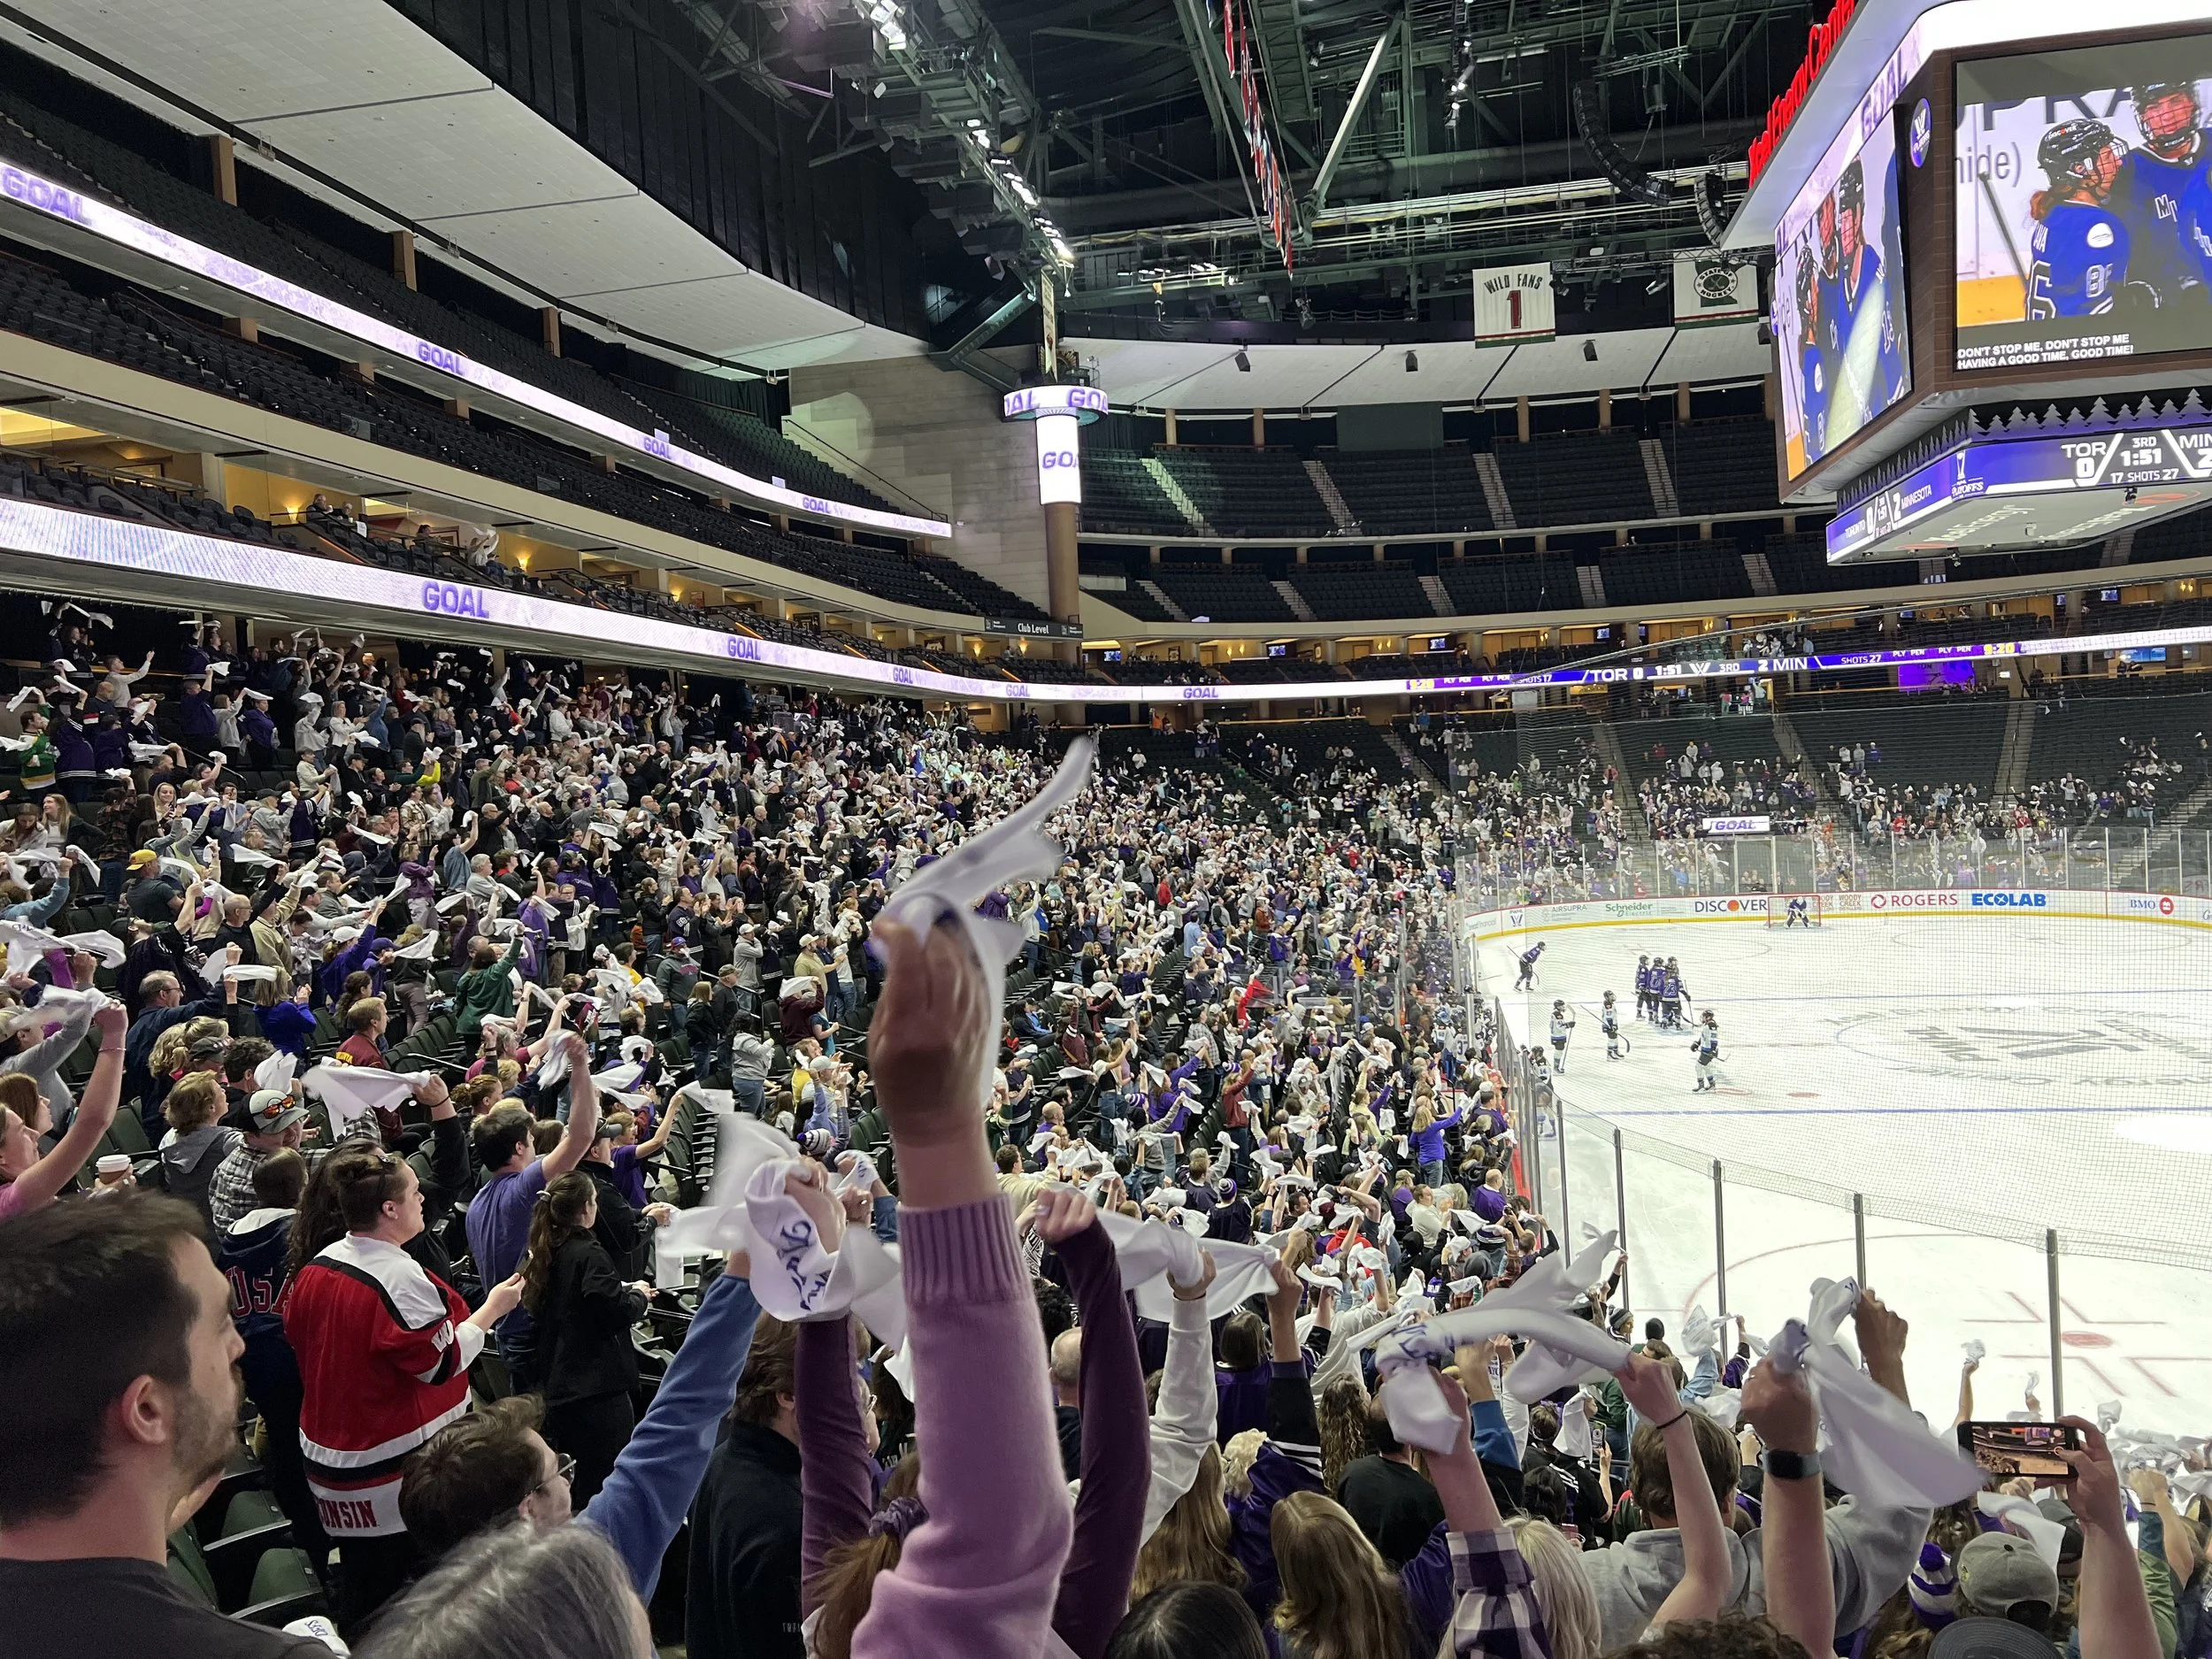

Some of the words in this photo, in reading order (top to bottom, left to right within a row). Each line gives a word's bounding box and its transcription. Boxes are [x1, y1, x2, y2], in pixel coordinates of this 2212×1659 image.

[1861, 48, 1908, 133] GOAL
[3, 167, 92, 227] GOAL
[1484, 274, 1510, 294] WILD
[1517, 273, 1543, 289] FANS
[1700, 287, 1732, 297] HOCKEY
[1507, 290, 1522, 329] 1
[1957, 346, 1991, 358] DON'T
[1993, 343, 2022, 355] STOP
[2024, 342, 2043, 352] ME,
[2046, 338, 2078, 350] DON'T
[2081, 335, 2110, 348] STOP
[2113, 334, 2130, 344] ME
[418, 342, 465, 376] GOAL
[1957, 357, 1996, 370] HAVING
[1998, 357, 2008, 366] A
[2008, 353, 2039, 365] GOOD
[2041, 351, 2069, 362] TIME,
[2072, 349, 2103, 358] GOOD
[2105, 345, 2133, 357] TIME!
[643, 436, 671, 459] GOAL
[2061, 442, 2107, 458] TOR
[2131, 436, 2157, 449] 3RD
[2120, 448, 2162, 466] 1:51
[2076, 457, 2095, 478] 0
[2110, 472, 2124, 483] 17
[2126, 471, 2160, 482] SHOTS
[2162, 468, 2179, 480] 27
[803, 495, 832, 513] GOAL
[1893, 492, 1901, 522] 2
[1901, 484, 1932, 511] MINNESOTA
[422, 580, 489, 618] GOAL
[1018, 623, 1031, 634] Club
[1032, 624, 1049, 634] Level
[727, 636, 761, 661] GOAL
[1589, 668, 1628, 682] TOR
[1655, 664, 1682, 676] 1:51
[1719, 663, 1740, 672] 3RD
[1758, 659, 1768, 672] 2
[1772, 657, 1808, 671] MIN
[1840, 656, 1868, 664] SHOTS
[1869, 654, 1882, 663] 27
[1984, 642, 2015, 655] 9:20
[893, 667, 913, 685] GOAL
[1005, 684, 1031, 697] GOAL
[1183, 687, 1218, 699] GOAL
[1715, 819, 1756, 830] GOAL
[1605, 902, 1653, 912] Schneider
[1694, 899, 1767, 912] DISCOVER
[1892, 894, 1958, 907] ROGERS
[1972, 893, 2046, 907] ECOLAB
[2130, 899, 2155, 909] BMO
[1663, 983, 1677, 995] 23
